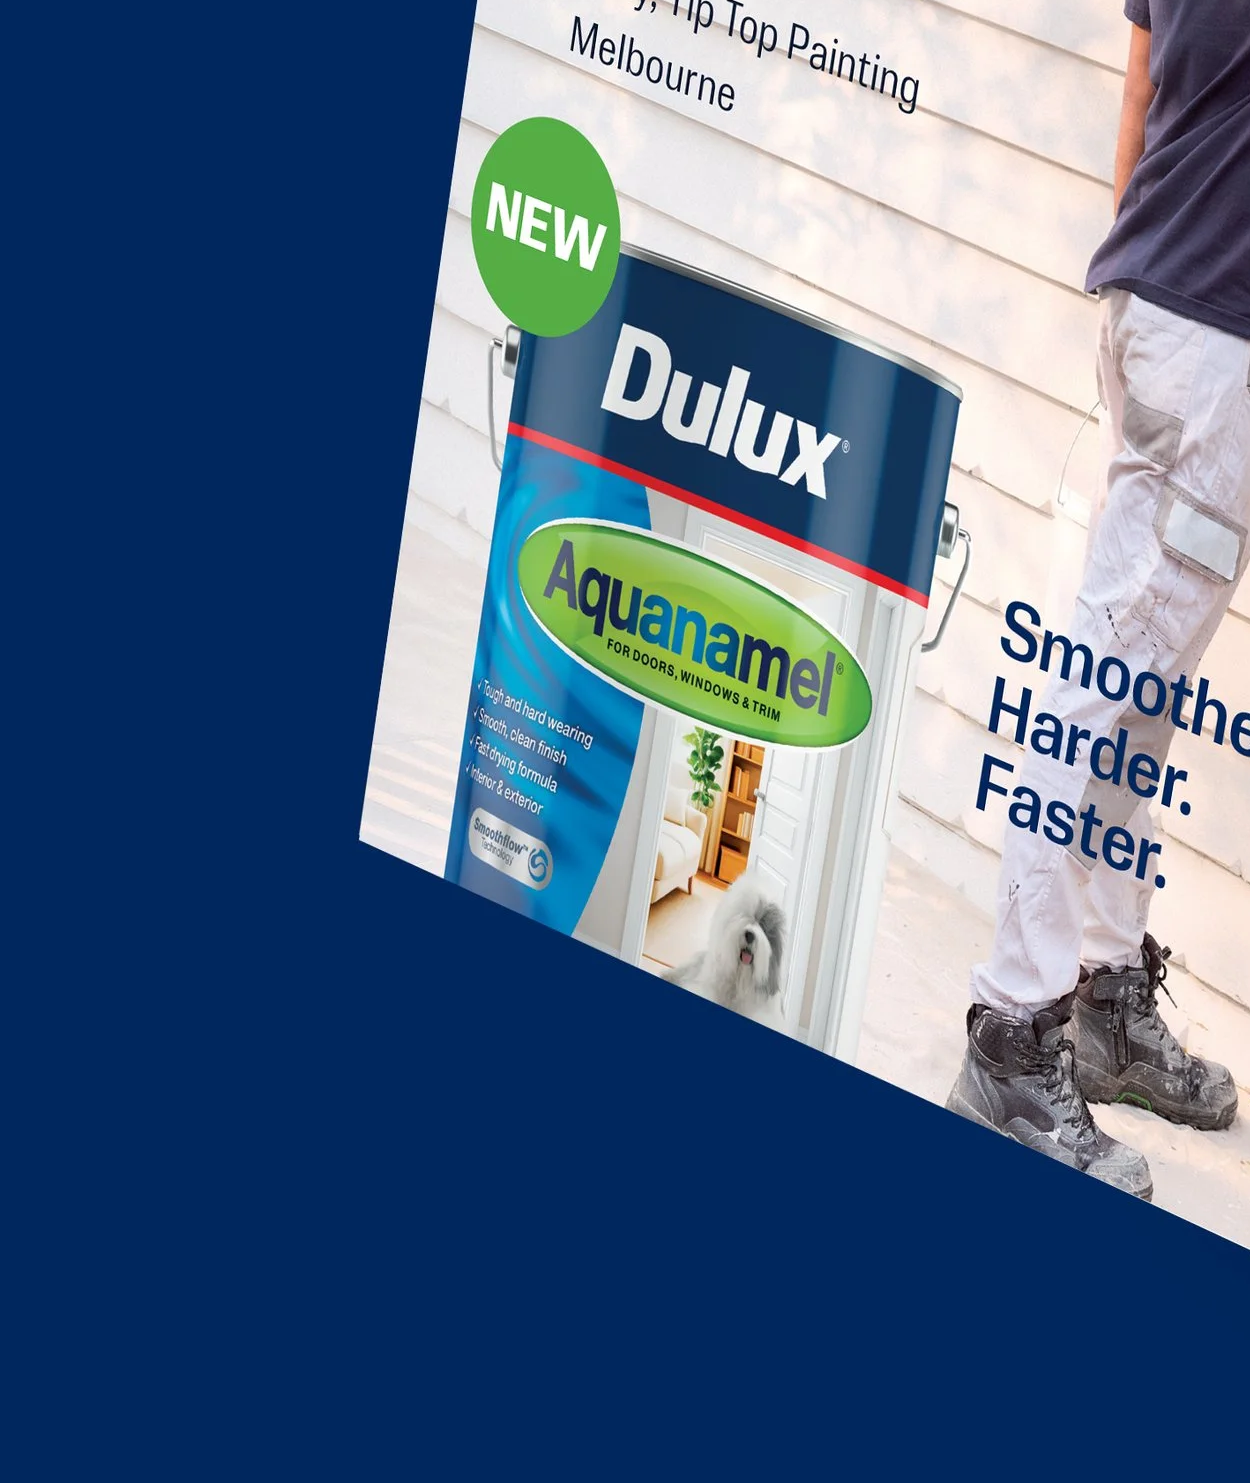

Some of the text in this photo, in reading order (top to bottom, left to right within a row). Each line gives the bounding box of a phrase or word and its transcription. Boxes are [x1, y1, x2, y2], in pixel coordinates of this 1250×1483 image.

[570, 16, 736, 112] Melbourne
[787, 23, 920, 114] Painting
[485, 181, 608, 272] NEW
[601, 323, 842, 500] Dulux
[543, 540, 836, 717] Aquanamel
[483, 679, 594, 751] Tough and hard wearing
[607, 638, 780, 722] FOR DOORS, WINDOWS & TRIM
[474, 735, 558, 793] Fast drying formula
[478, 708, 568, 766] Smooth, clean finish
[987, 675, 1192, 815] Harder.
[470, 763, 544, 816] Interior & exterior
[975, 753, 1167, 889] Faster.
[481, 836, 515, 867] Technology
